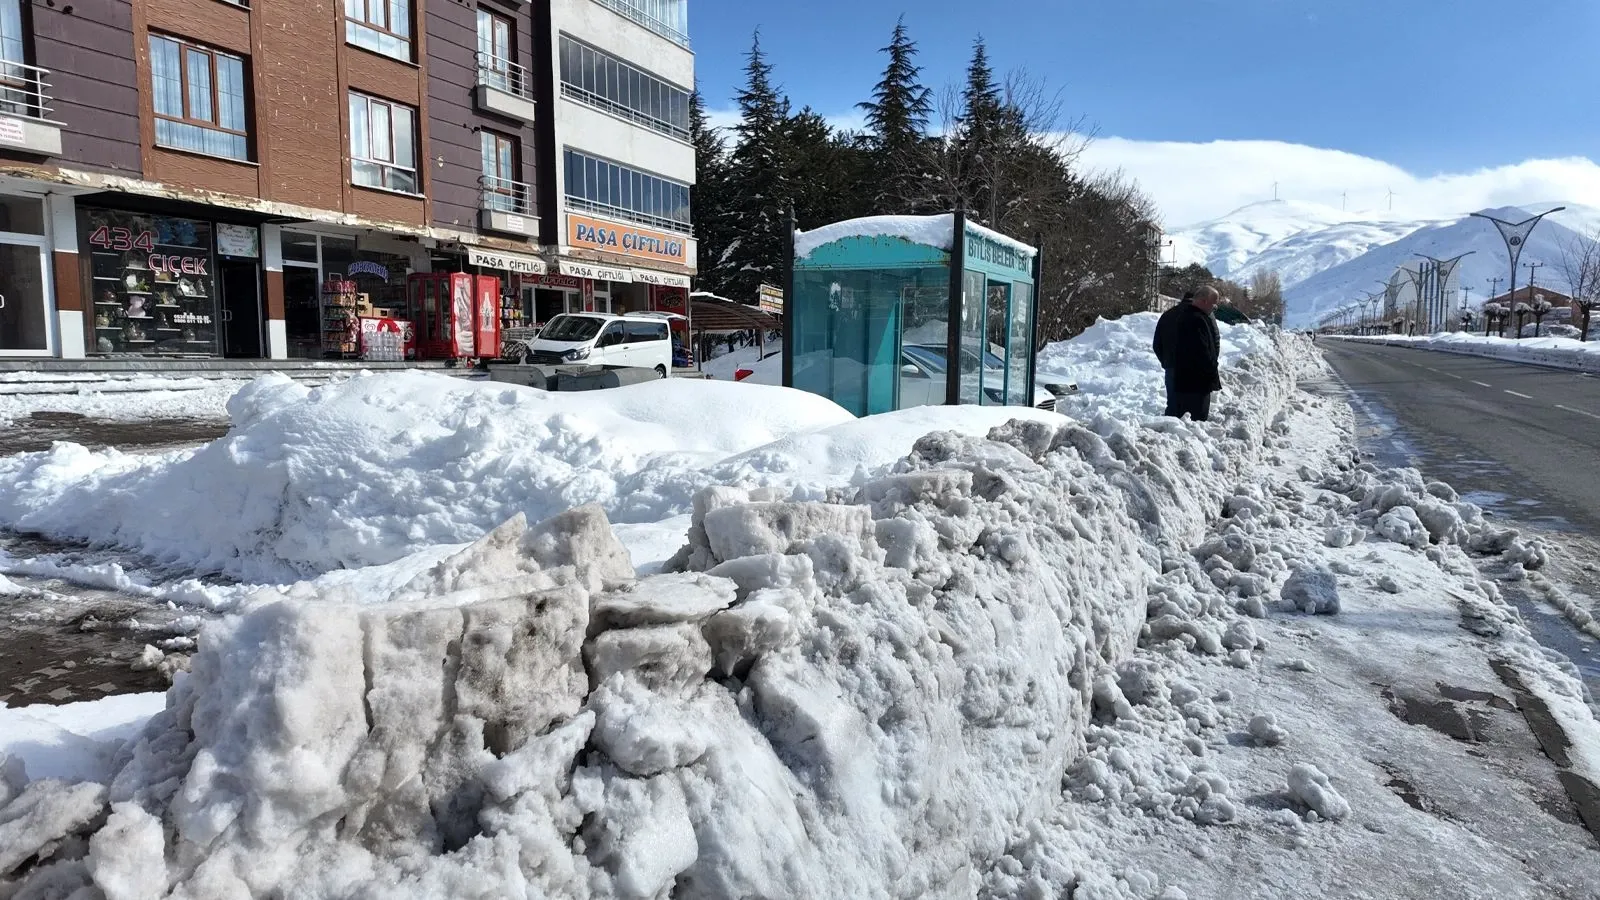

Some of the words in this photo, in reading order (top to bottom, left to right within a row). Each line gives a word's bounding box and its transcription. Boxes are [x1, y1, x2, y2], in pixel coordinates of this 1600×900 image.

[89, 225, 155, 253] 434
[575, 223, 618, 249] PAŞA
[476, 255, 504, 268] PAŞA
[569, 266, 593, 278] PAŞA
